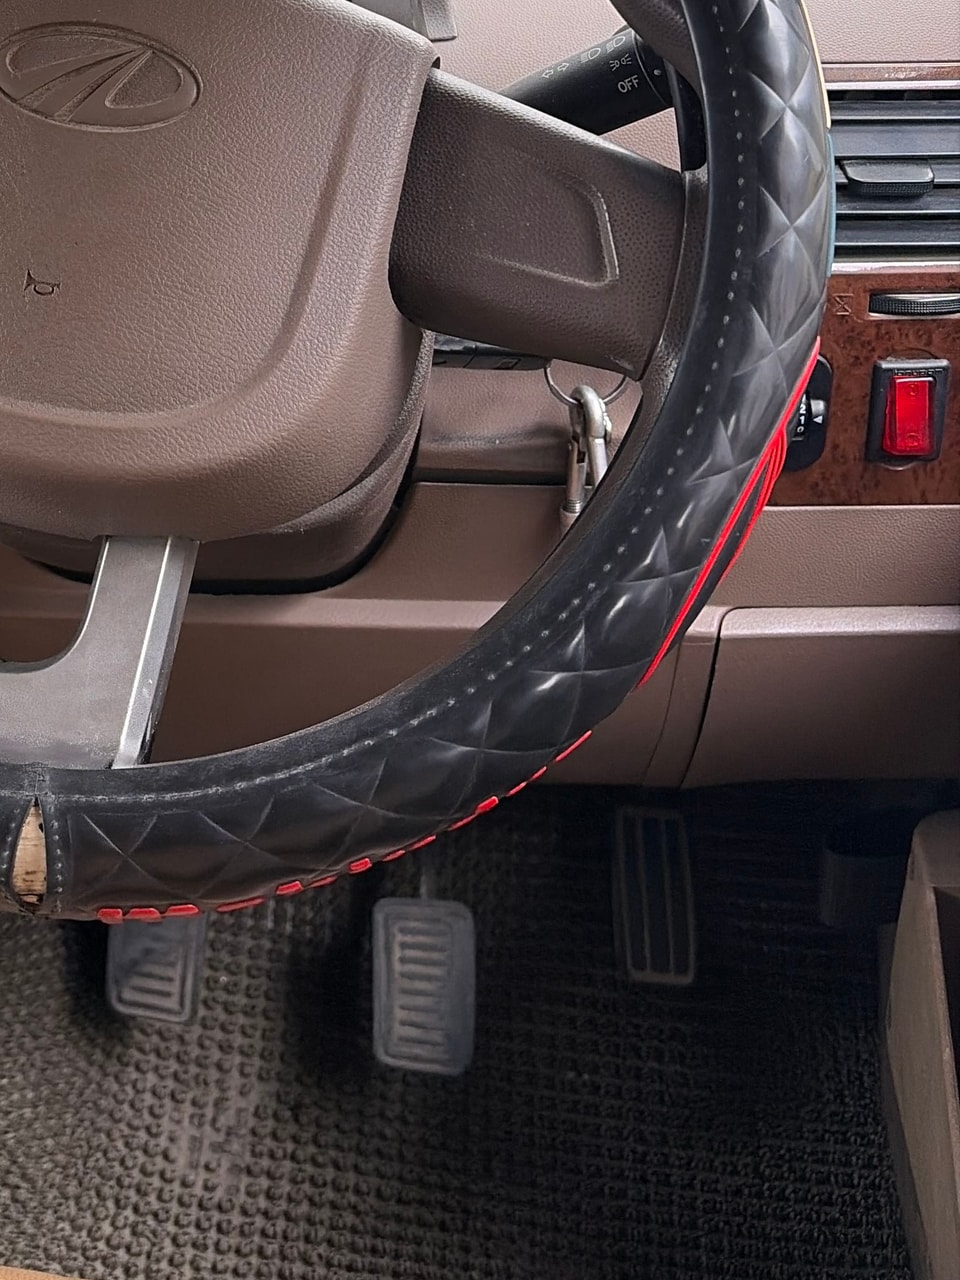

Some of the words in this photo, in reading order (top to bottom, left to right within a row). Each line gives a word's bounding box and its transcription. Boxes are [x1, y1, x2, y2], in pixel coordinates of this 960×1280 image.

[617, 75, 639, 93] OFF
[799, 403, 807, 414] 2
[799, 415, 806, 425] 1
